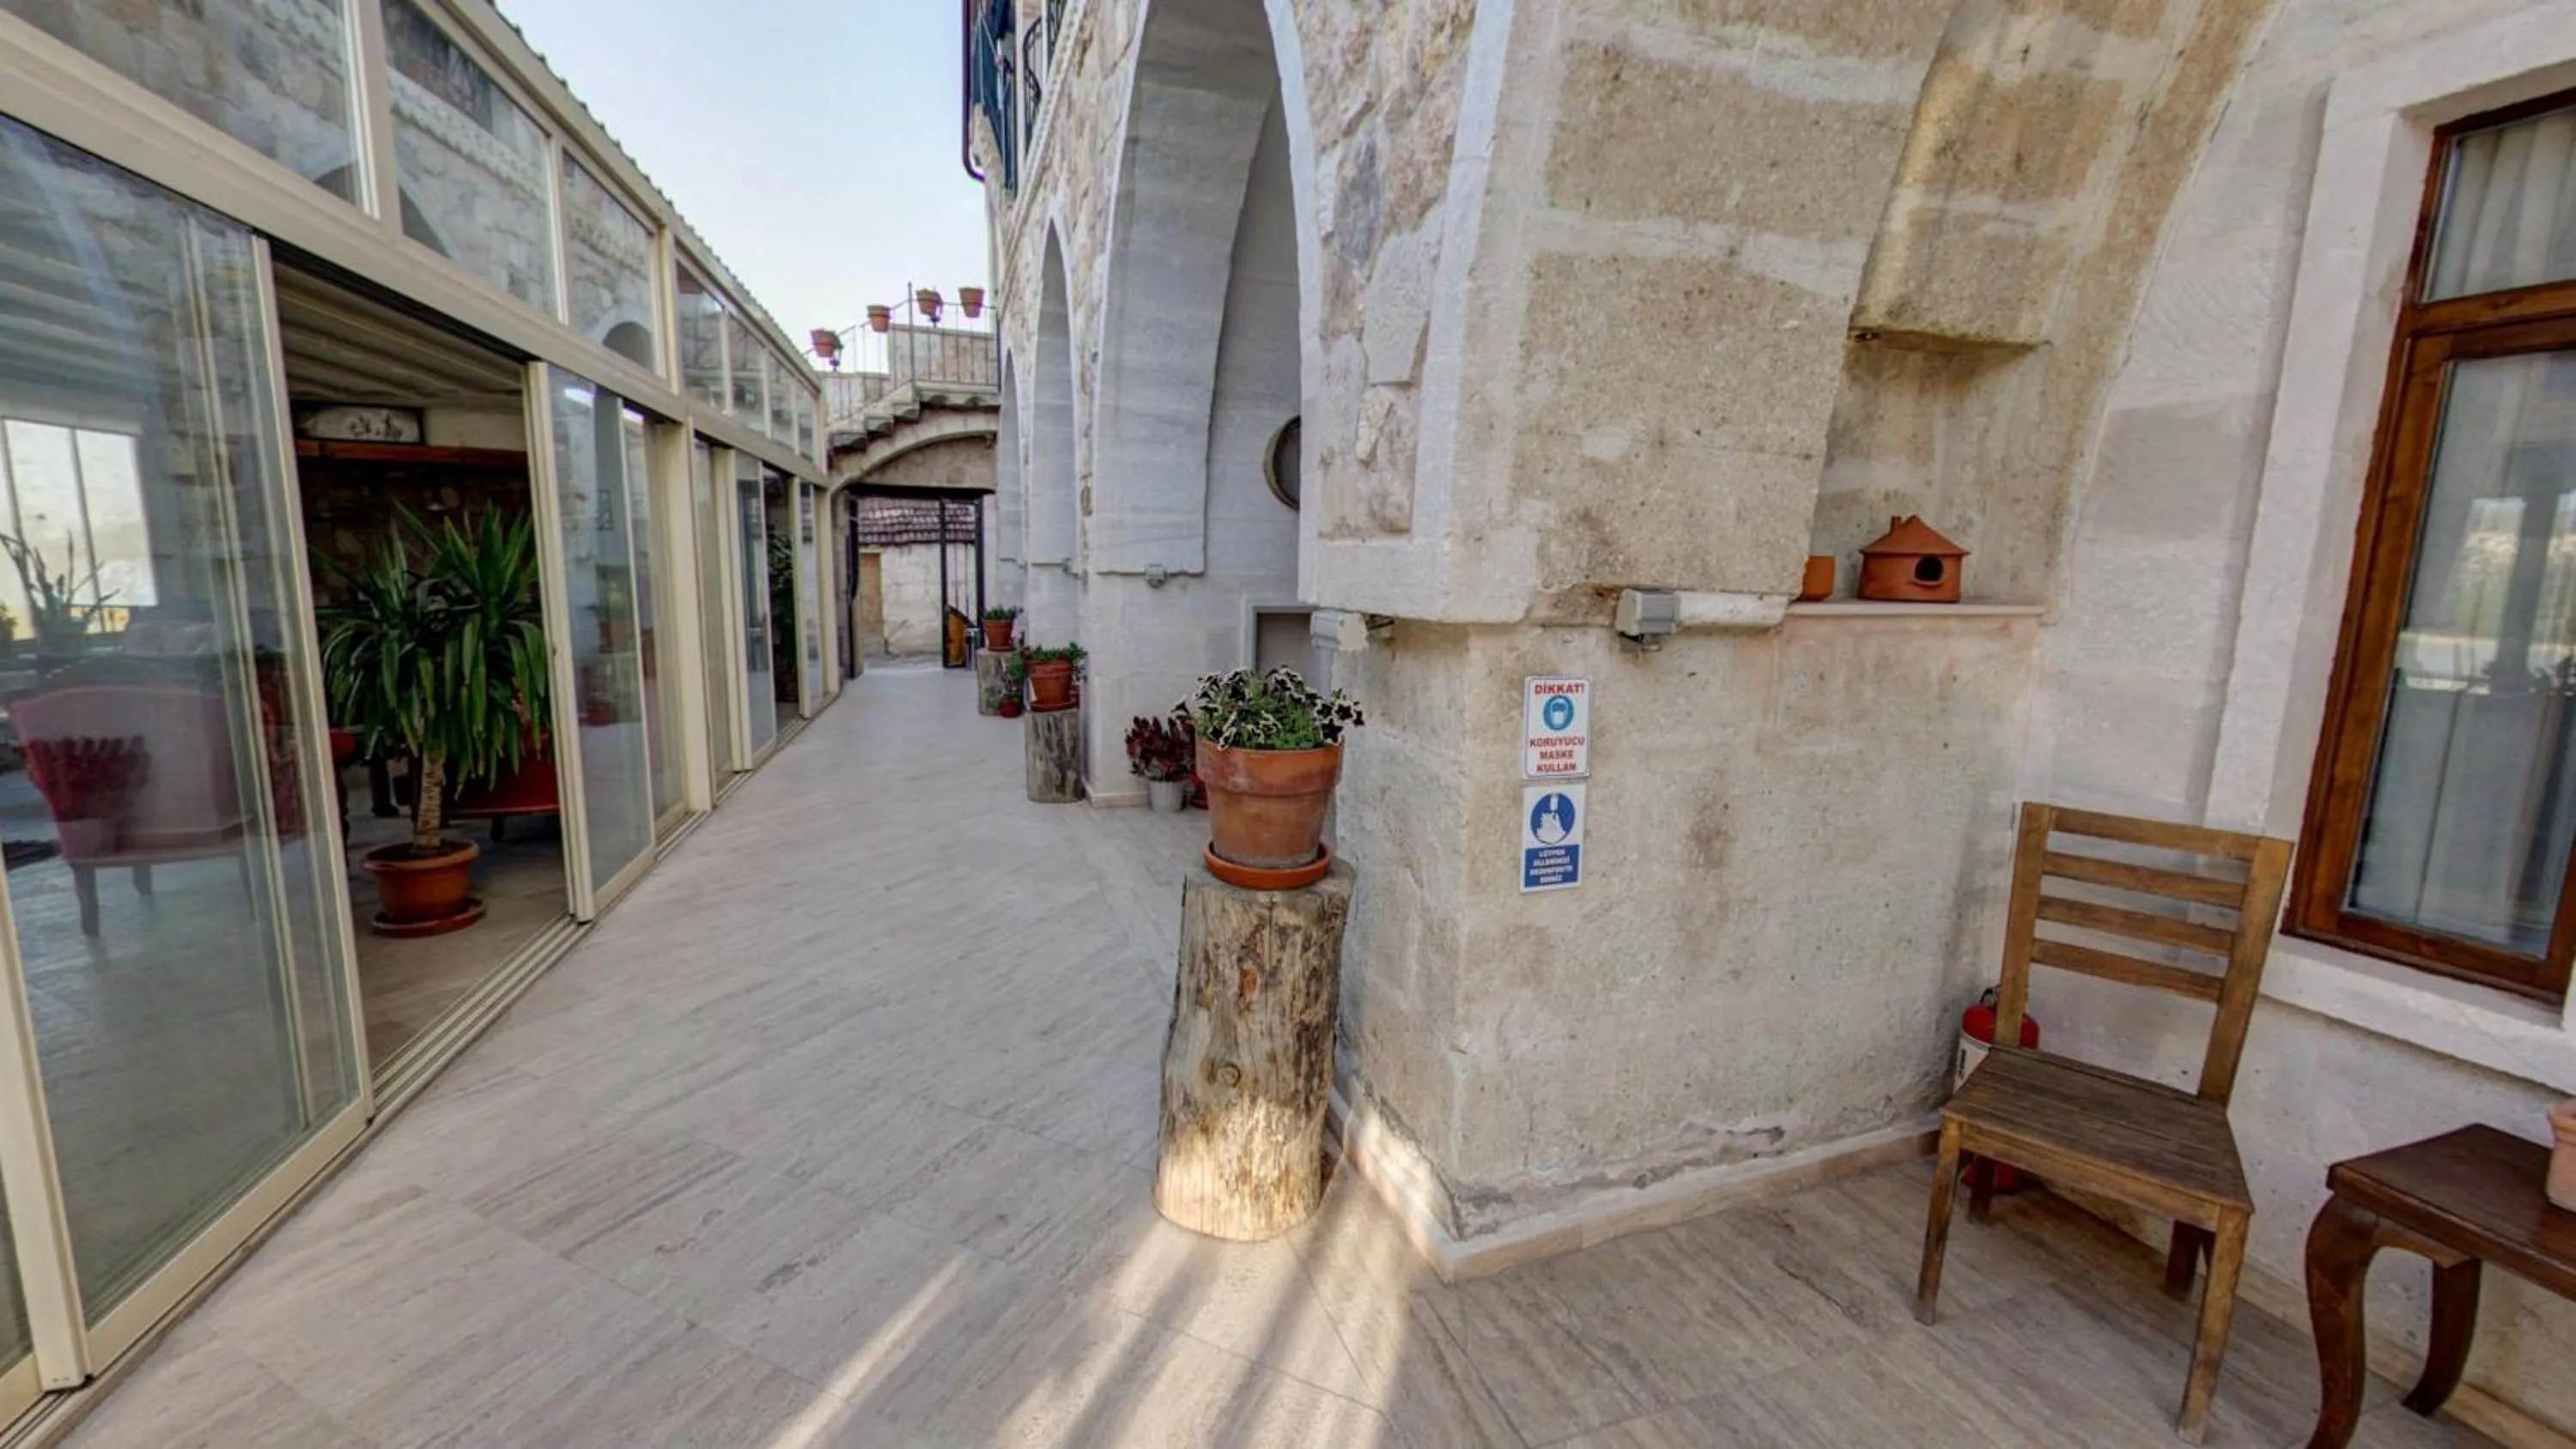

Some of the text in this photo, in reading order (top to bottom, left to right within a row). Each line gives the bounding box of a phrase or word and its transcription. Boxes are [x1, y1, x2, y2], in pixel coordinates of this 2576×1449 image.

[1529, 736, 1585, 747] KORUYUCU
[1540, 750, 1574, 760] MASKE
[1537, 762, 1577, 772] KULLAN
